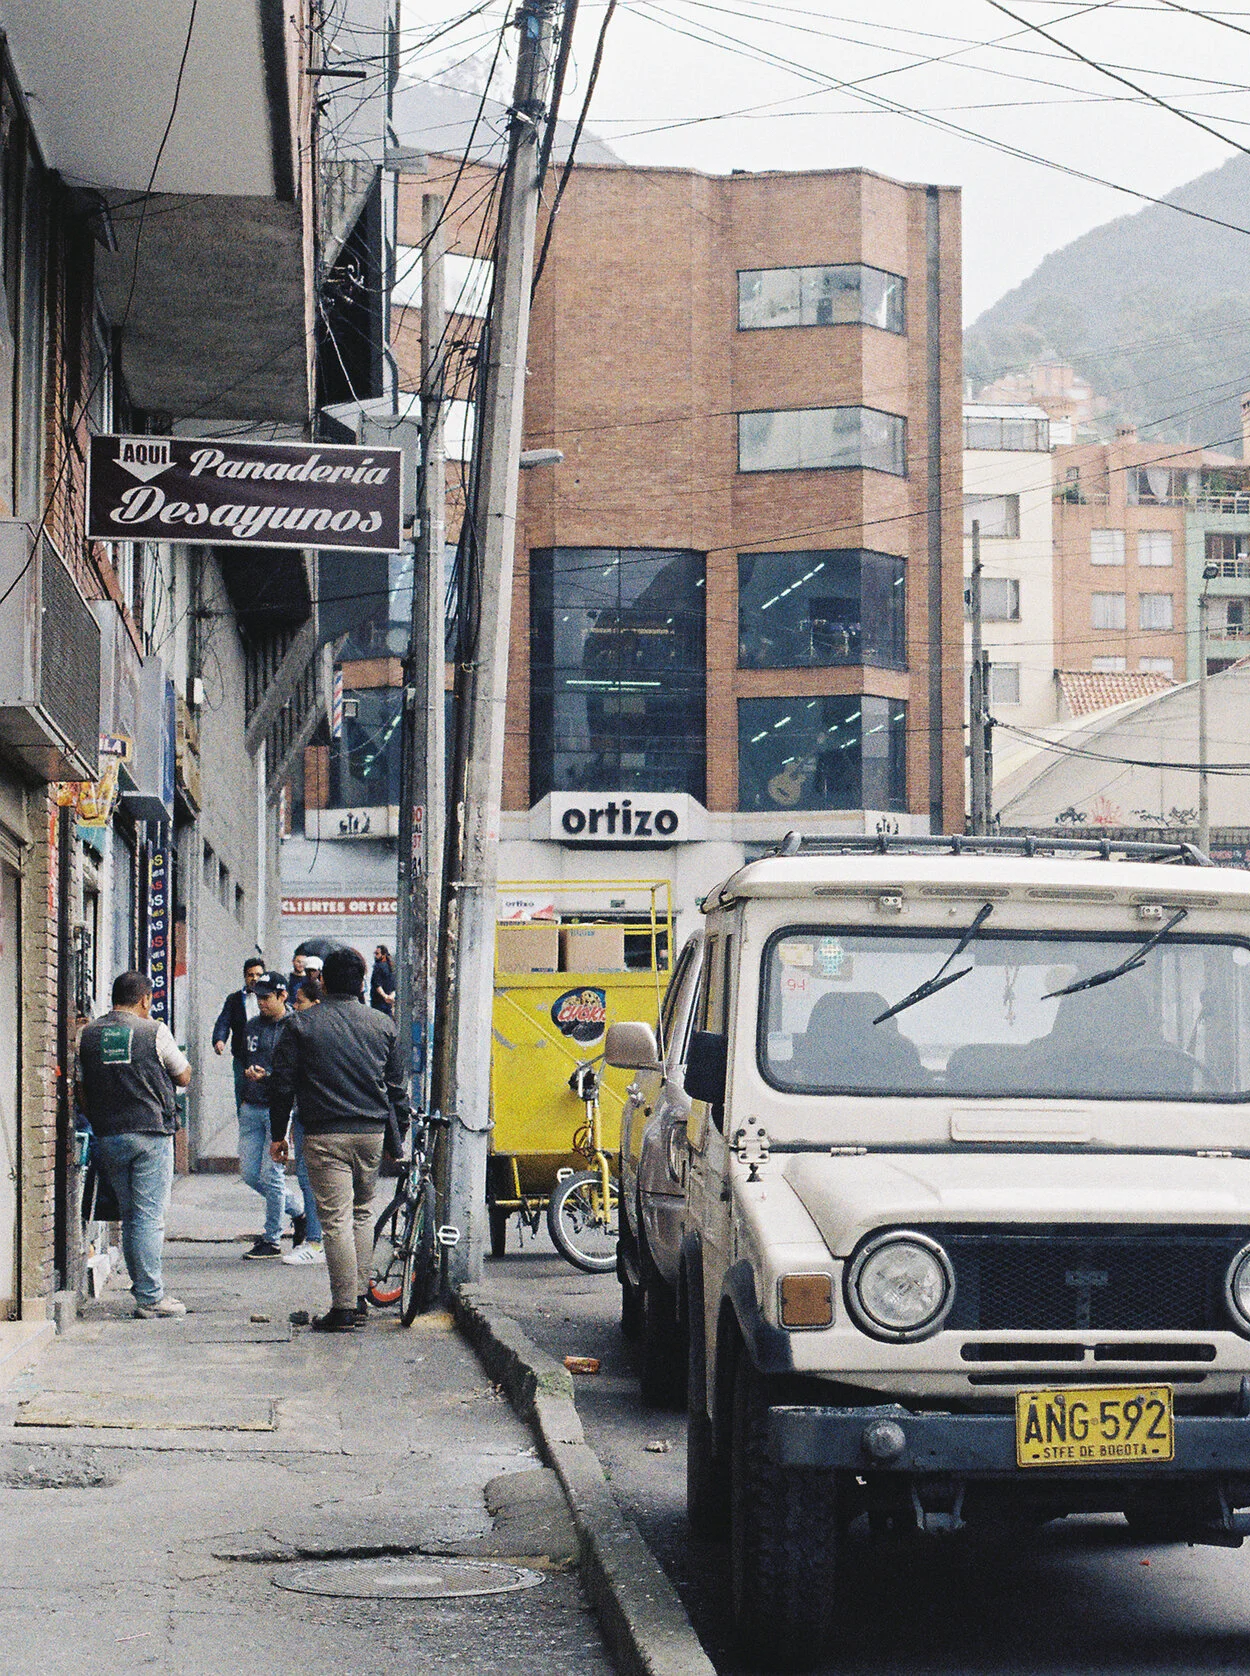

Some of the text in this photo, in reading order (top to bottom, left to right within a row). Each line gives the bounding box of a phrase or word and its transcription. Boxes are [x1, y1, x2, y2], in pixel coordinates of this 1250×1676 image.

[123, 442, 168, 465] AQUI
[189, 448, 391, 486] Panadería
[109, 485, 383, 539] Desayunos
[561, 799, 679, 836] ortizo
[282, 901, 346, 913] CLIENTES
[557, 1005, 606, 1022] CHOKI
[1024, 1399, 1167, 1444] ANG 592
[1043, 1443, 1148, 1459] STFE DE BOGOTA
